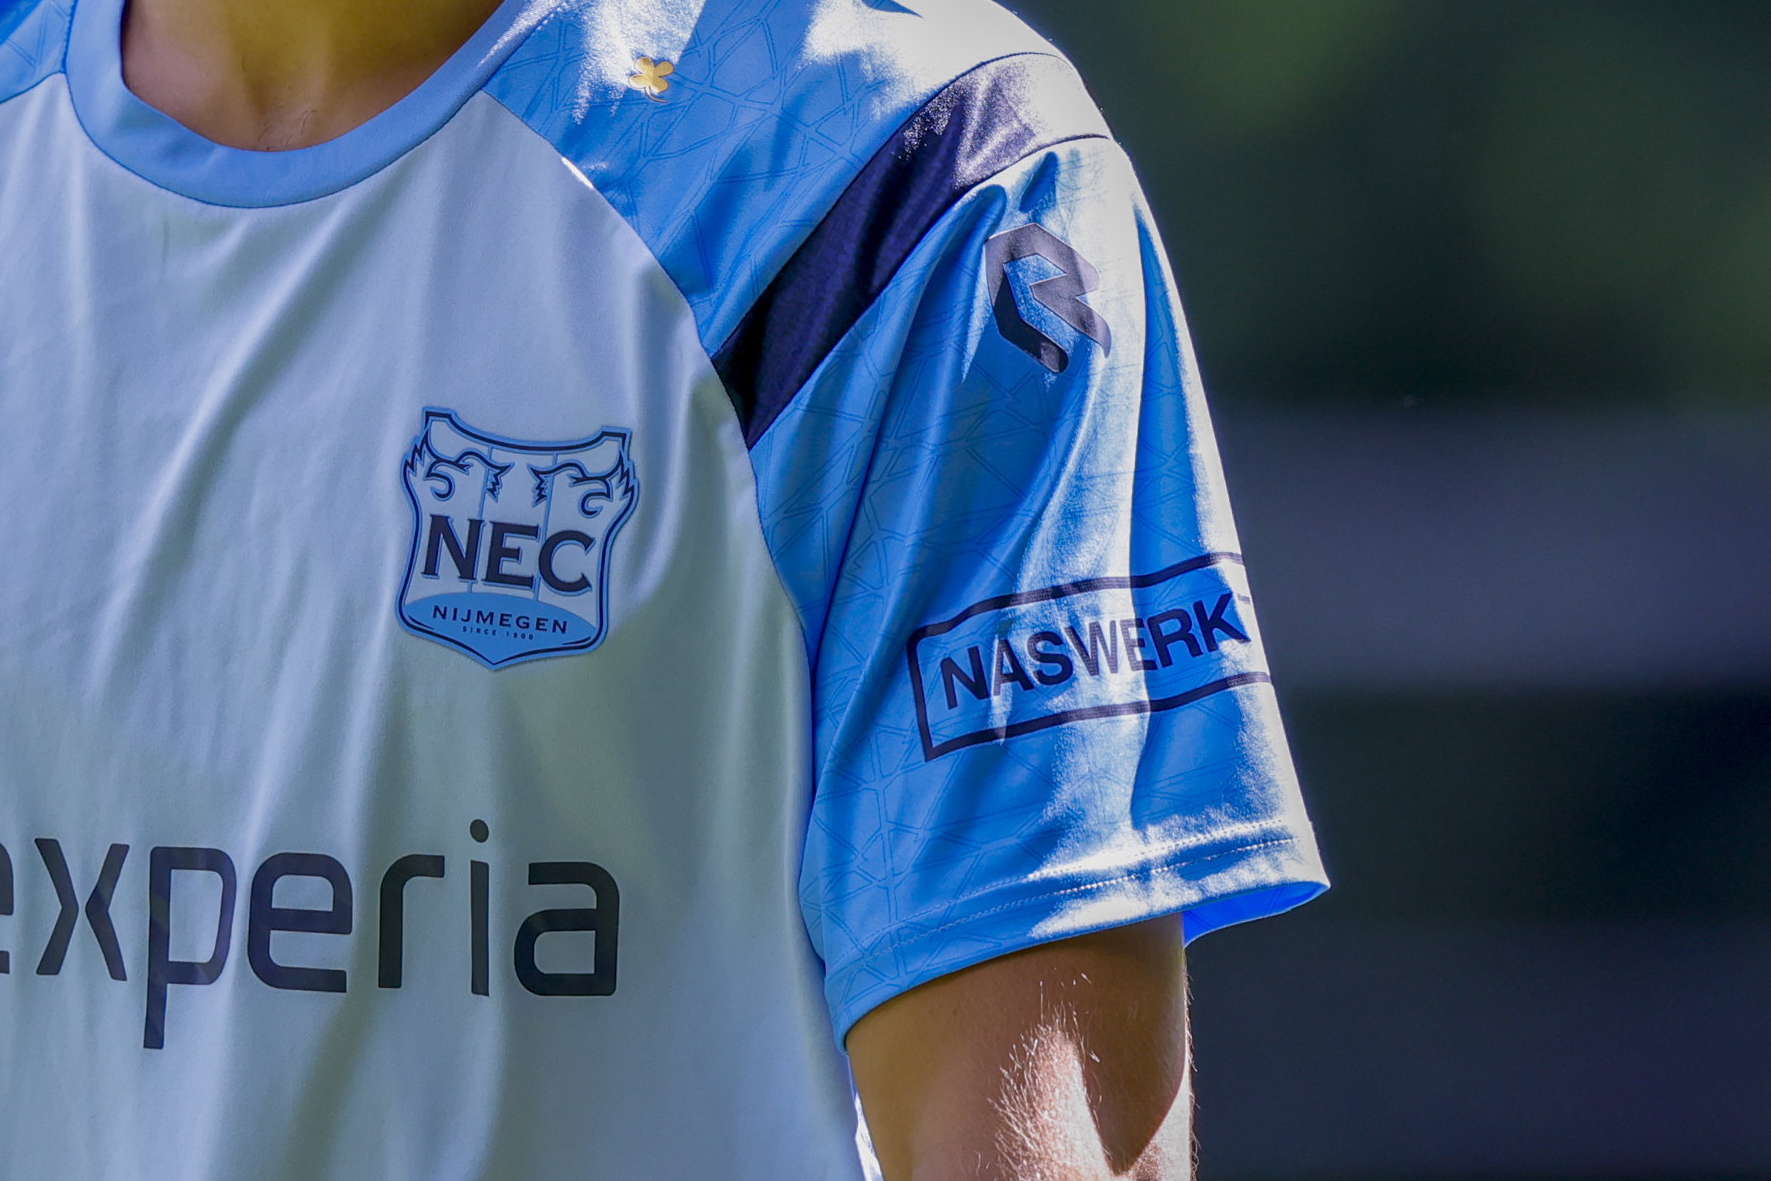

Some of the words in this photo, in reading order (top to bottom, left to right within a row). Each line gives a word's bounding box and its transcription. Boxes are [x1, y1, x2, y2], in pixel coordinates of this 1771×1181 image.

[421, 514, 595, 594] NEC
[432, 605, 568, 634] NIJMEGEN
[462, 625, 497, 636] SINCE
[940, 591, 1251, 710] NASWERK
